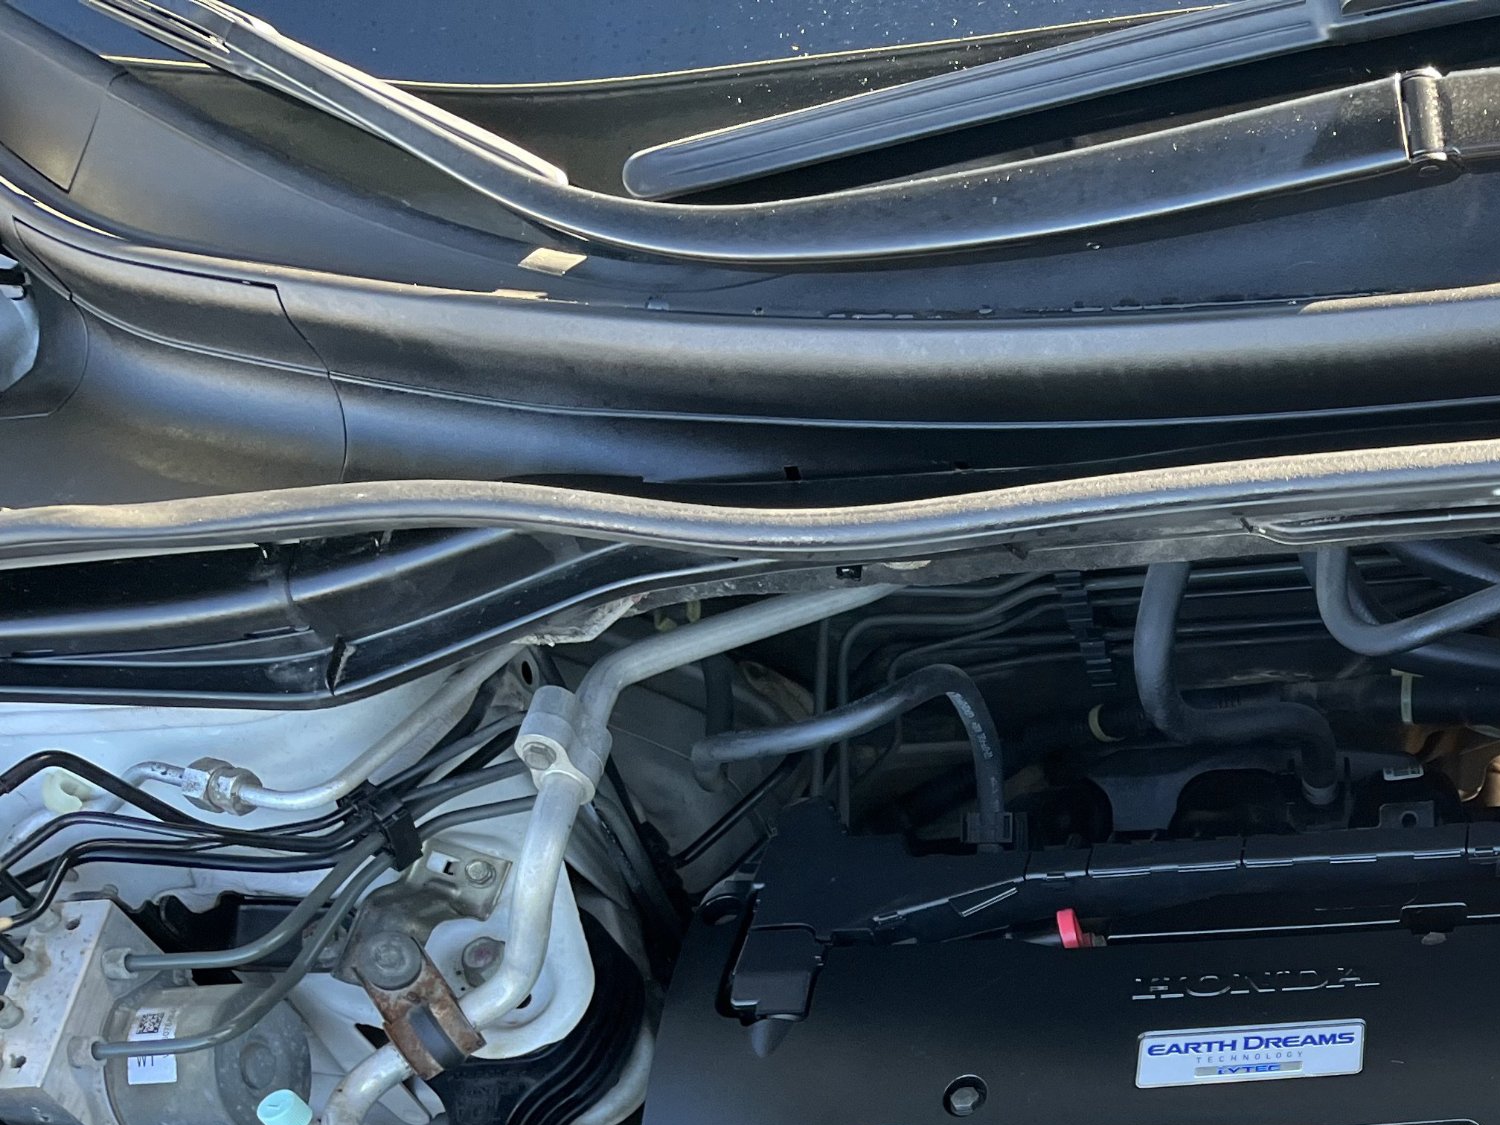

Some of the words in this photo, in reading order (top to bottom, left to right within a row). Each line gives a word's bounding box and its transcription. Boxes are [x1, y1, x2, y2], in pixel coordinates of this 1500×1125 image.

[1132, 967, 1380, 1000] HONDA
[1148, 1040, 1236, 1056] EARTH
[1243, 1032, 1355, 1051] DREAMS
[1197, 1051, 1303, 1064] TECHNOLOGY
